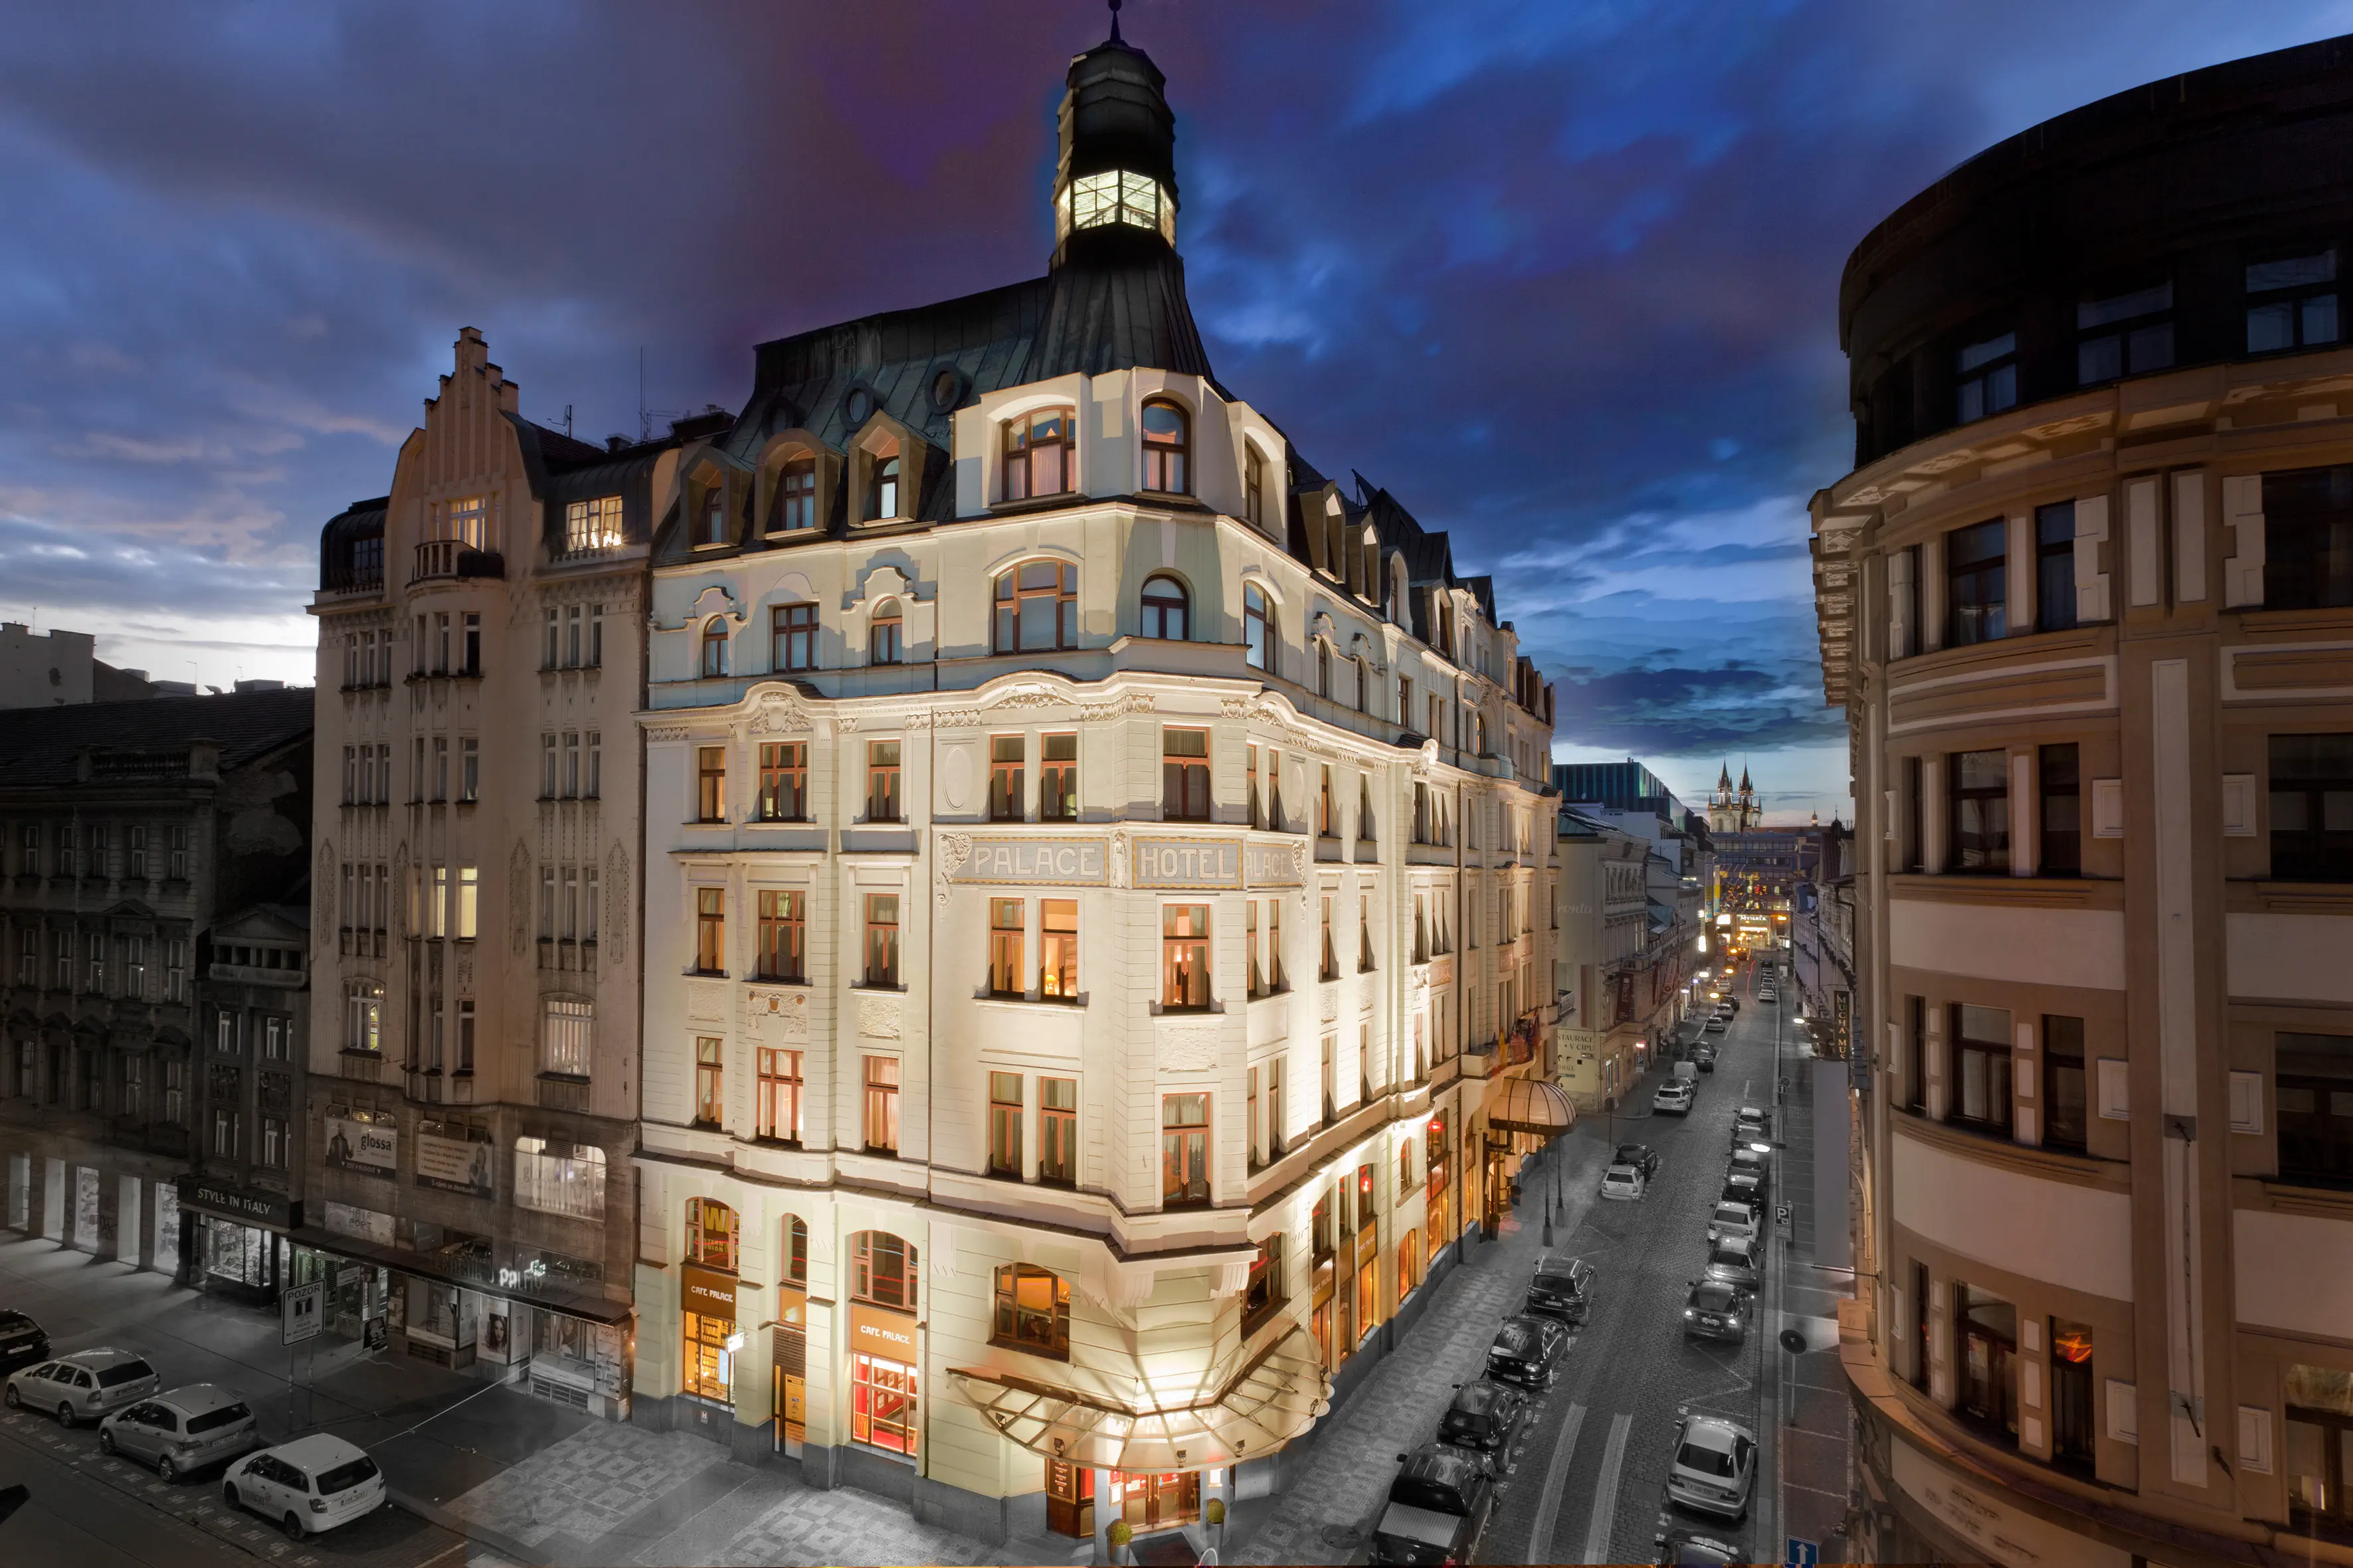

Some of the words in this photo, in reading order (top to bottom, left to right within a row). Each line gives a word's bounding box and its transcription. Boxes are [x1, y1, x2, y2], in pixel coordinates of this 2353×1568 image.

[974, 846, 1099, 876] PALACE
[1139, 847, 1237, 879] HOTEL
[1837, 996, 1846, 1034] MUCHA
[361, 1133, 391, 1152] glossa
[197, 1187, 226, 1205] STYLE
[229, 1195, 240, 1208] IN
[243, 1197, 271, 1215] ITALY
[1777, 1207, 1787, 1219] P
[288, 1284, 321, 1301] POZOR
[691, 1286, 708, 1296] CAFE
[709, 1289, 733, 1302] PALACE
[860, 1325, 881, 1337] CAFE
[882, 1330, 910, 1344] PALACE
